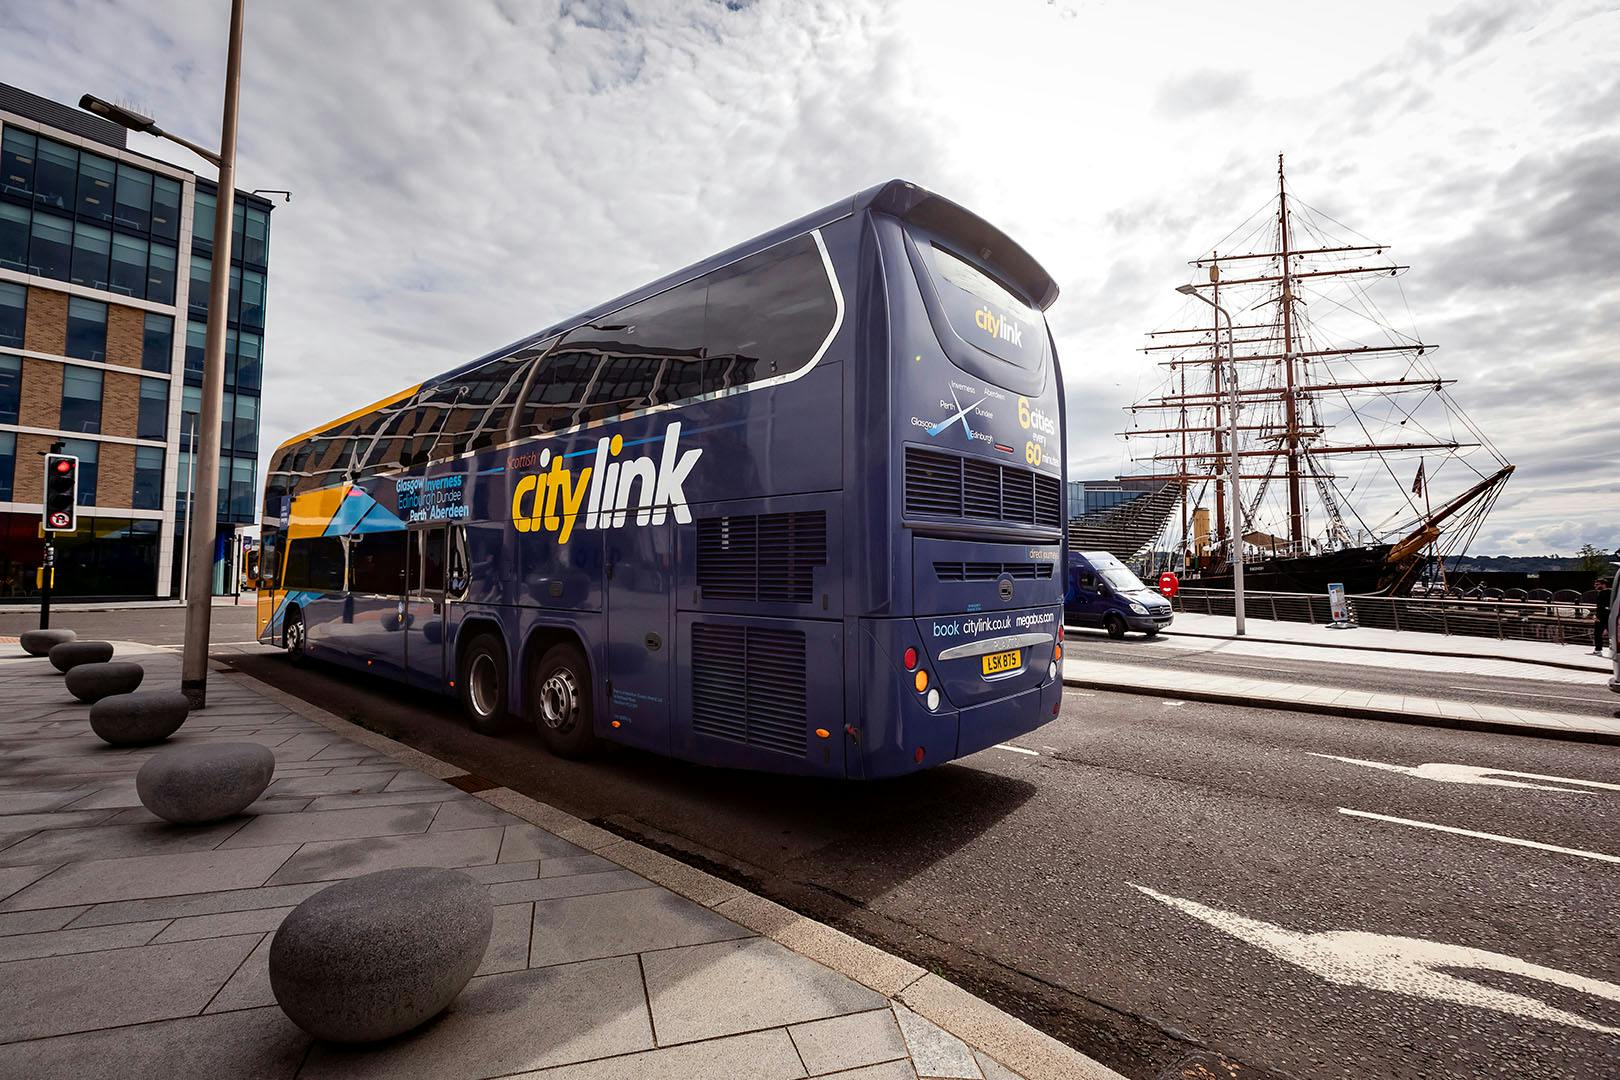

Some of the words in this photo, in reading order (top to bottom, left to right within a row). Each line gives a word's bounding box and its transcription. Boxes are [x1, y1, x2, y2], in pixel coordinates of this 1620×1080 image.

[975, 306, 1023, 348] citylink
[940, 399, 955, 411] Perth
[911, 417, 937, 430] Glasgow
[1018, 396, 1030, 429] 6
[1031, 408, 1055, 435] cities
[506, 452, 537, 470] Scottish
[1025, 441, 1041, 466] 60
[396, 478, 424, 494] Glasgow
[425, 475, 462, 491] Inverness
[512, 421, 703, 544] citylink
[398, 491, 436, 511] Edinburgh
[437, 489, 462, 504] Dundee
[410, 508, 427, 521] Perth
[430, 503, 469, 520] Aberdeen
[933, 621, 960, 637] book
[963, 615, 1012, 636] citylink.co.uk
[988, 655, 1002, 670] LSK
